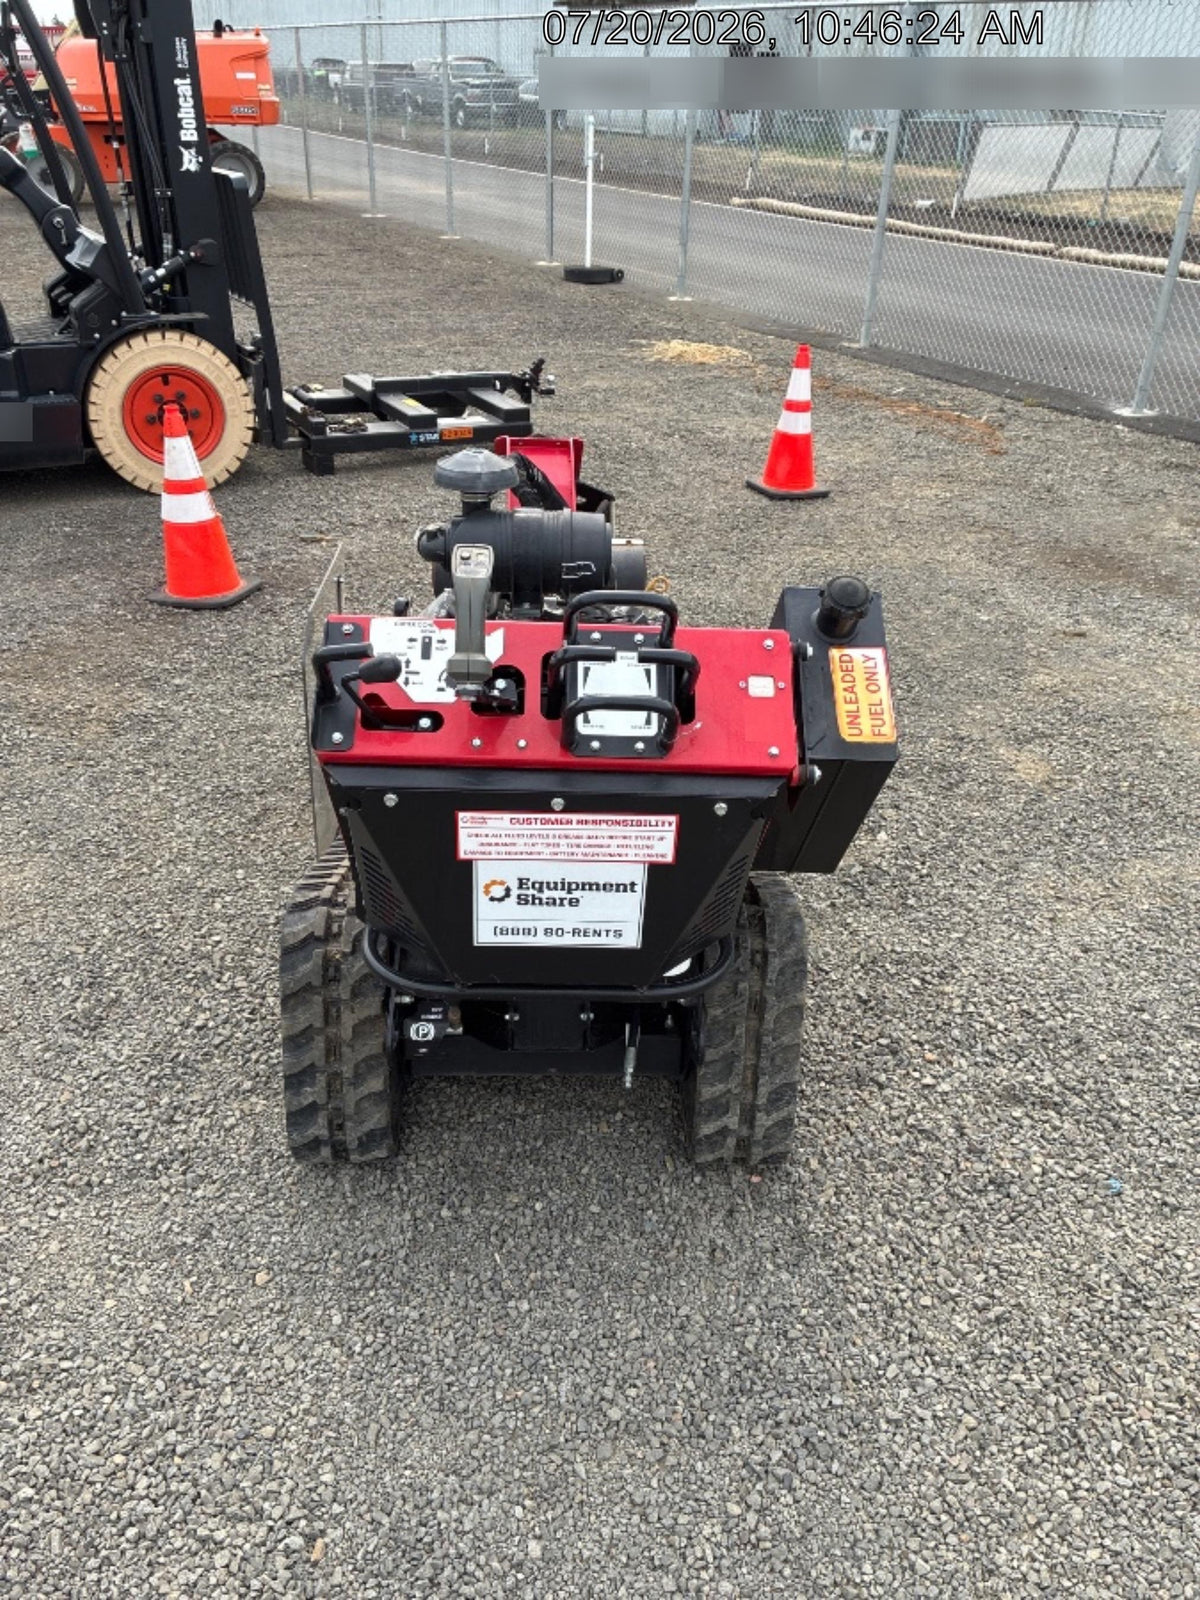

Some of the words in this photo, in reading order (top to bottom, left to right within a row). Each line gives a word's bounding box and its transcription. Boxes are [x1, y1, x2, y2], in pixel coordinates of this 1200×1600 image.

[174, 77, 199, 141] Bobcat
[862, 654, 881, 693] ONLY
[838, 653, 863, 737] UNLEADED
[868, 699, 887, 737] FUEL
[509, 817, 573, 827] CUSTOMER
[575, 818, 675, 828] RESPONSIBILITY
[516, 877, 637, 896] Equipment
[516, 893, 581, 908] Share
[493, 926, 538, 938] (888)
[543, 926, 623, 939] 80-RENTS
